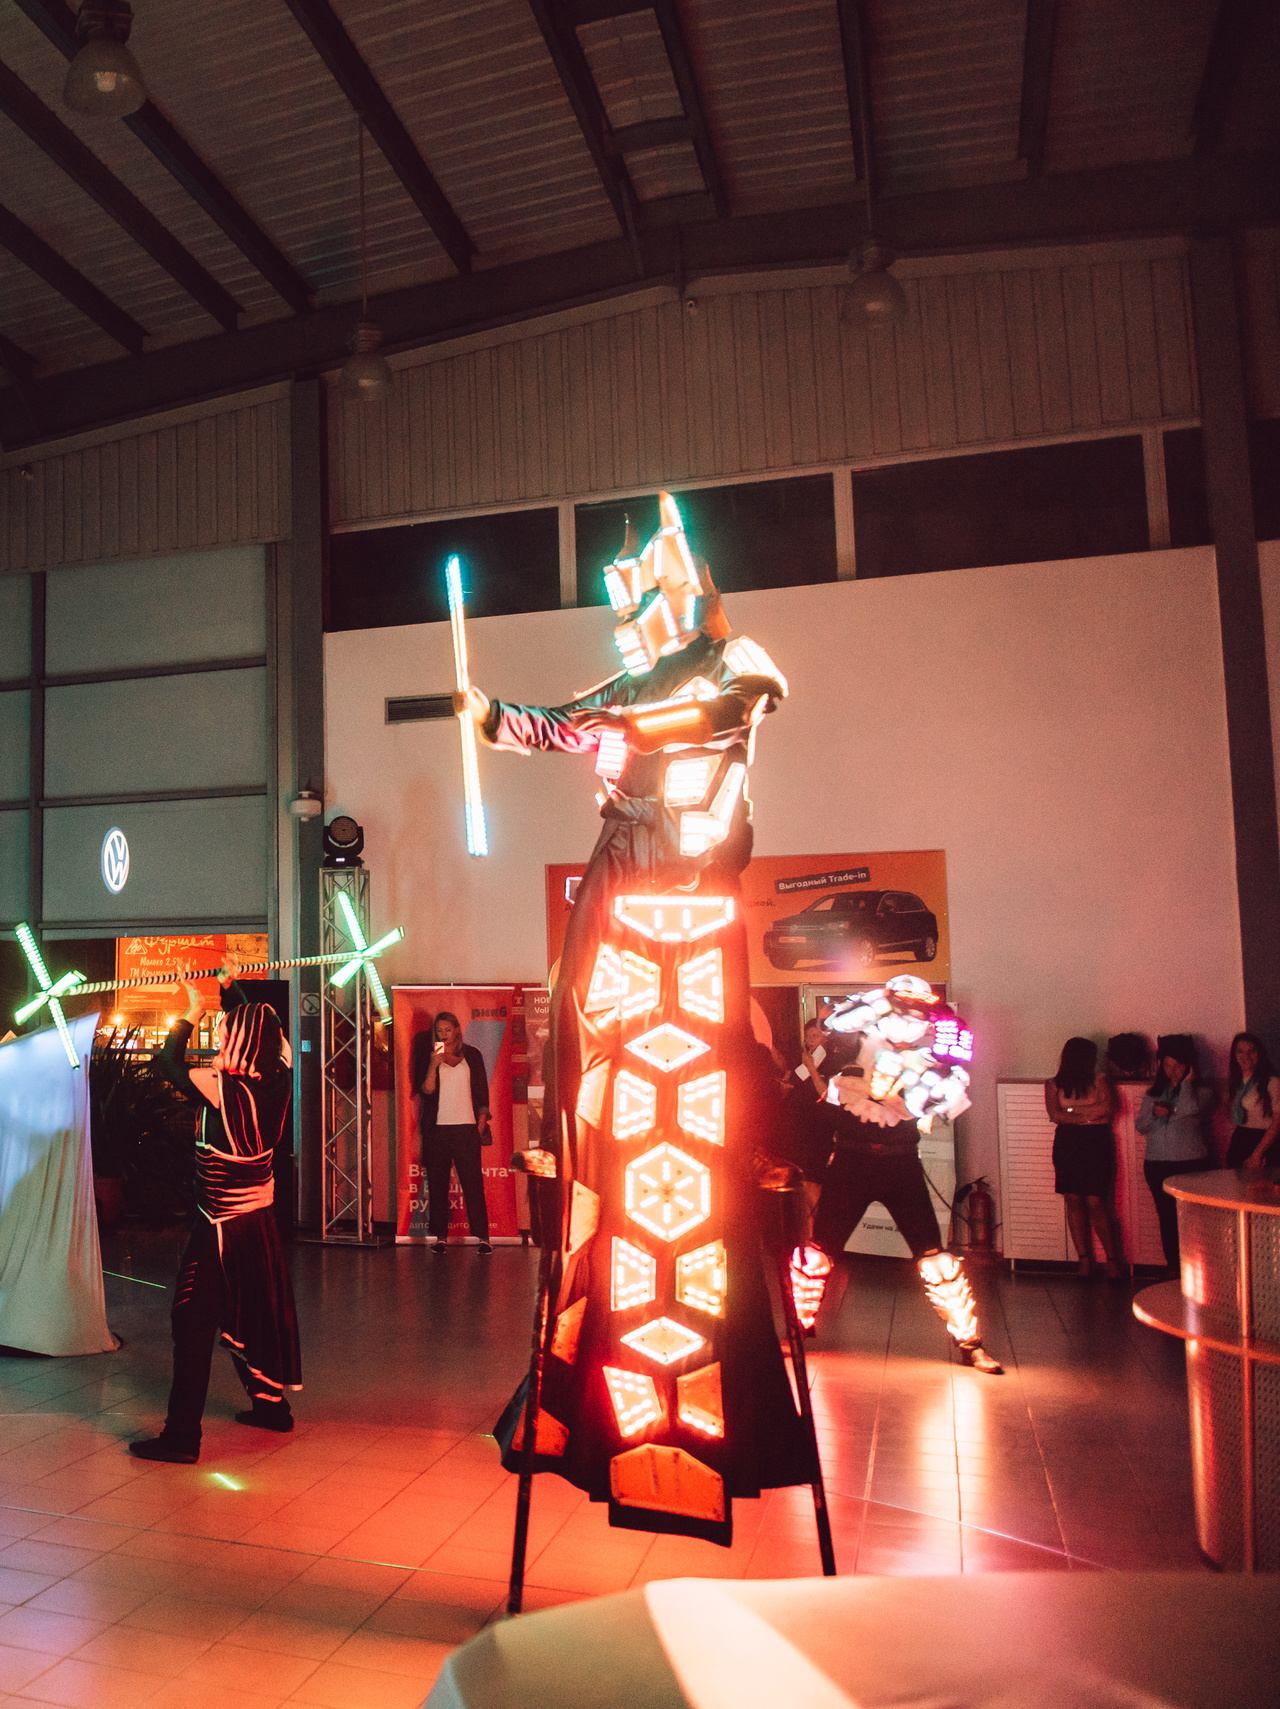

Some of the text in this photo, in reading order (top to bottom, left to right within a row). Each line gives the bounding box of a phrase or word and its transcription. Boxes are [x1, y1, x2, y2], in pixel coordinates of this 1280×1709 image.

[778, 871, 867, 890] Выгодный Trade-in
[409, 1197, 464, 1212] рух!
